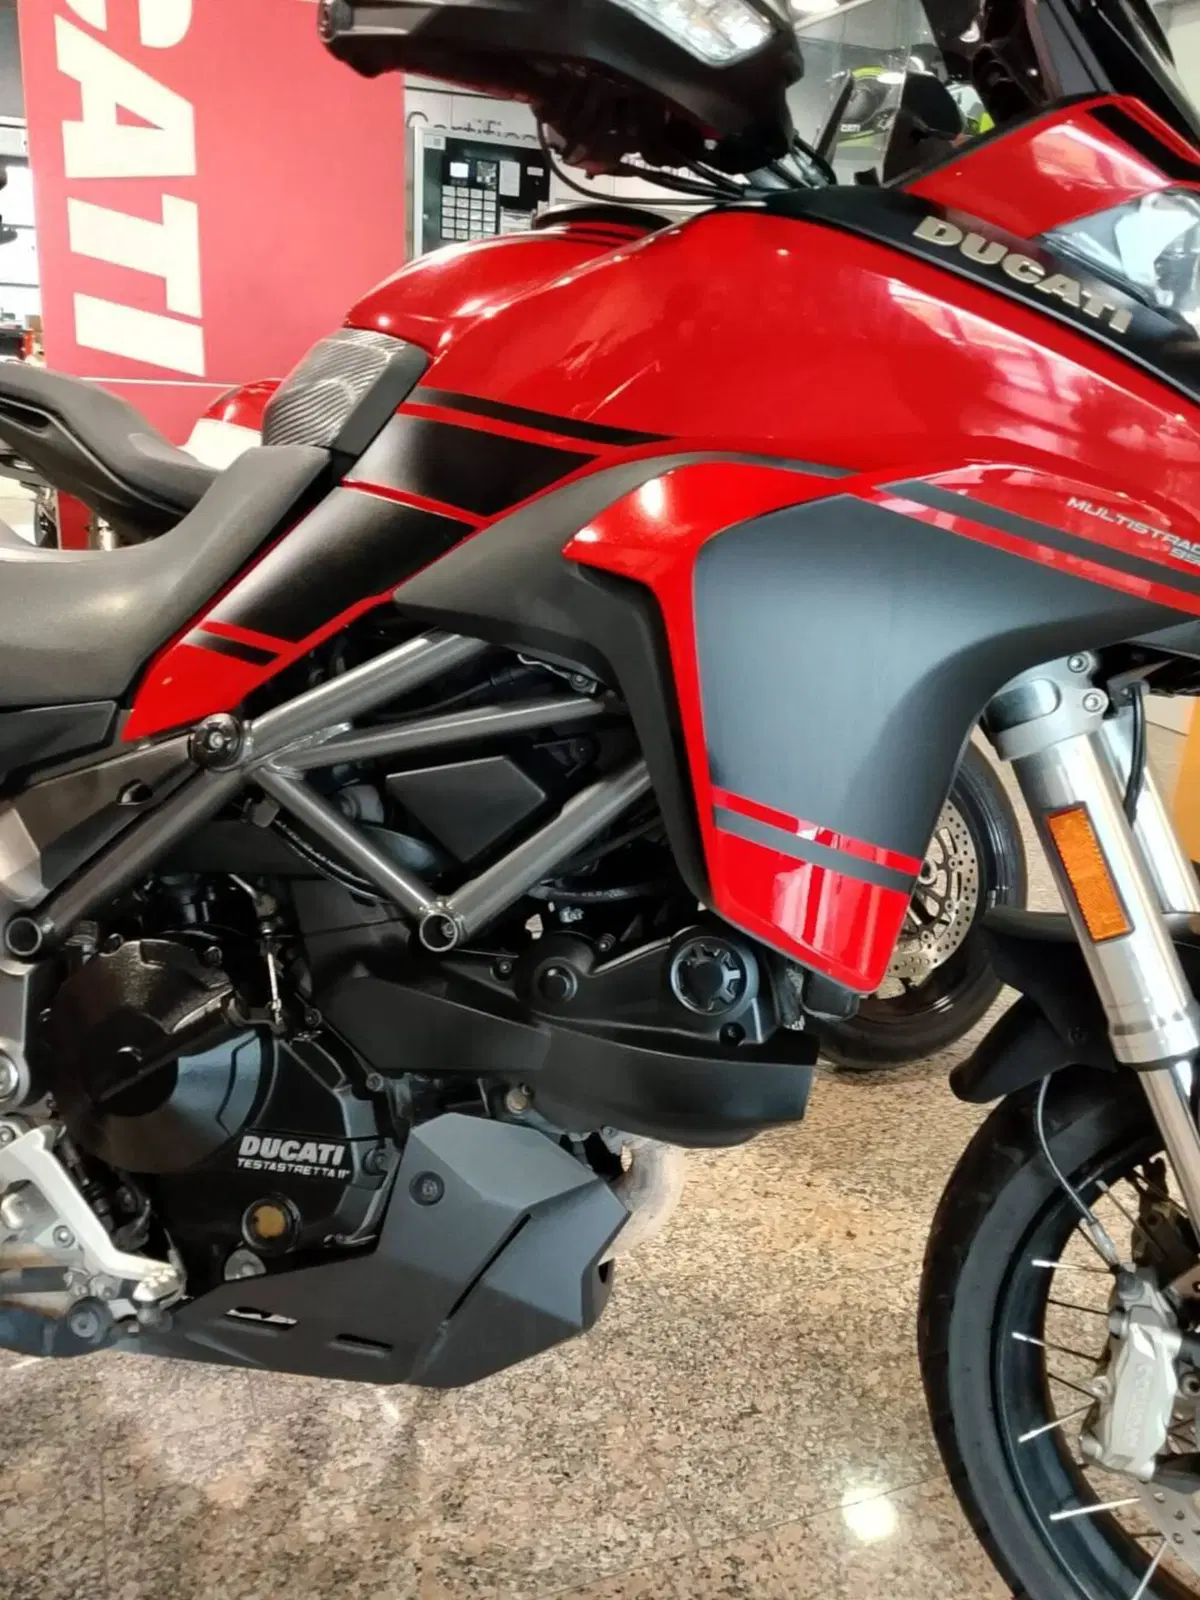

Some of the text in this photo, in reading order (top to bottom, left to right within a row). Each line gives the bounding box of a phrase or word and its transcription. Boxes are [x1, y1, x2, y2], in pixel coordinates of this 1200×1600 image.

[912, 215, 1133, 335] DUCATI
[238, 1135, 345, 1166] DUCATI
[236, 1157, 336, 1179] TESTASTRETTA
